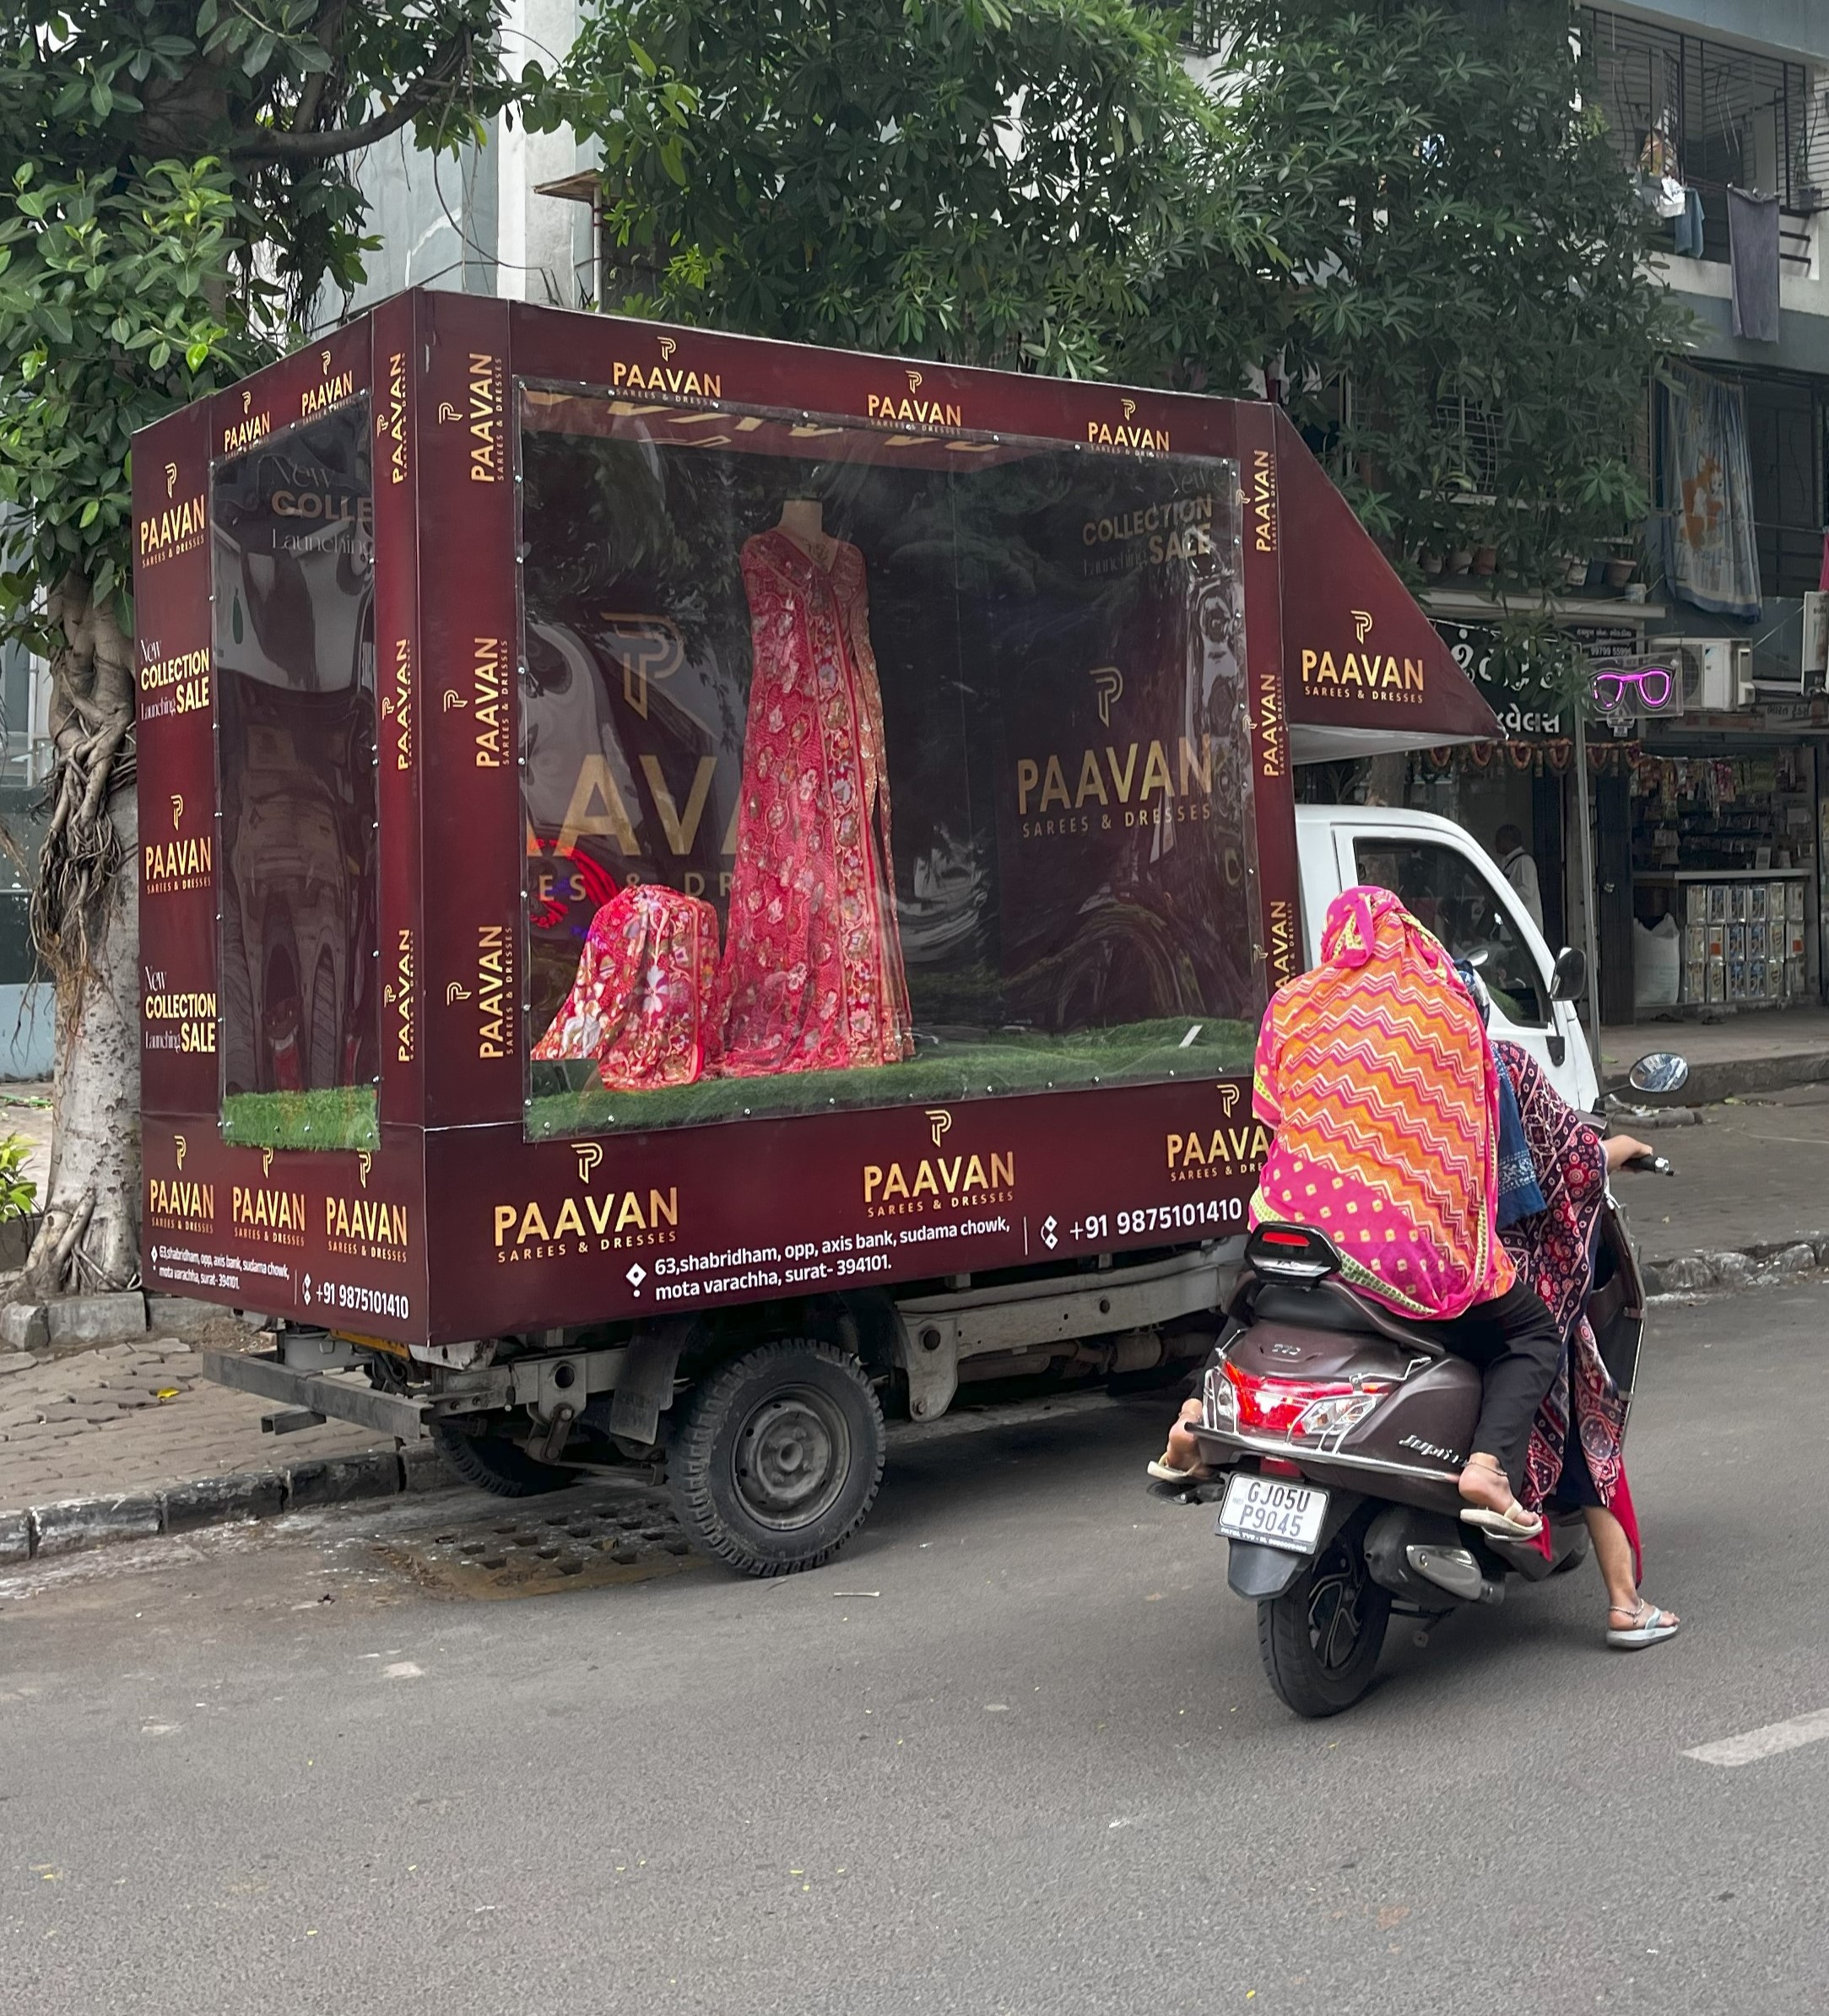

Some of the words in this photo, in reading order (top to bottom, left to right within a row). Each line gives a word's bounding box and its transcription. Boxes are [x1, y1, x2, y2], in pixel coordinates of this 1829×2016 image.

[301, 370, 353, 416] PAAVAN
[495, 358, 503, 412] DRESSES
[613, 362, 721, 398] PAAVAN
[225, 411, 270, 452] PAAVAN
[390, 353, 404, 484] PAAVAN
[469, 353, 495, 483] PAAVAN
[868, 394, 961, 427] PAAVAN
[1088, 422, 1169, 451] PAAVAN
[1083, 493, 1212, 546] COLLECTION
[1254, 450, 1271, 552] PAAVAN
[141, 494, 205, 555] PAAVAN
[1149, 522, 1211, 565] SALE
[141, 647, 209, 690] COLLECTION
[1301, 649, 1424, 691] PAAVAN
[176, 676, 209, 714] SALE
[396, 639, 409, 770] PAAVAN
[474, 638, 500, 767] PAAVAN
[1305, 685, 1350, 698] SAREES
[1357, 689, 1365, 700] &
[1372, 691, 1423, 704] DRESSES
[501, 718, 510, 765] SAREES
[1260, 674, 1279, 776] PAAVAN
[1017, 732, 1212, 815] PAAVAN
[1022, 816, 1089, 838] SAREES
[1101, 814, 1112, 830] &
[1124, 803, 1210, 827] DRESSES
[145, 836, 211, 880] PAAVAN
[147, 882, 171, 894] SAREES
[182, 876, 211, 889] DRESSES
[505, 927, 513, 983] DRESSES
[1270, 900, 1291, 989] AAVAN
[145, 993, 217, 1019] COLLECTION
[398, 929, 410, 1062] PAAVAN
[479, 926, 504, 1058] PAAVAN
[181, 1022, 216, 1052] SALE
[1166, 1125, 1269, 1168] PAAVA
[863, 1151, 1015, 1203] PAAVAN
[1171, 1167, 1218, 1181] SAREES
[1225, 1165, 1233, 1176] &
[150, 1179, 214, 1219] PAAVAN
[232, 1186, 305, 1231] PAAVAN
[495, 1186, 678, 1247] PAAVAN
[868, 1201, 923, 1218] SAREES
[933, 1199, 941, 1209] &
[951, 1191, 1014, 1208] DRESSES
[1070, 1214, 1107, 1240] +91
[1117, 1197, 1242, 1235] 9875101410
[326, 1197, 407, 1246] PAAVAN
[327, 1240, 357, 1255] SAREES
[361, 1245, 366, 1257] &
[371, 1246, 407, 1262] DRESSES
[498, 1244, 566, 1263] SAREES
[578, 1241, 588, 1253] &
[601, 1230, 676, 1251] DRESSES
[655, 1243, 782, 1276] 63,shabridham,
[785, 1242, 819, 1262] opp,
[822, 1235, 852, 1254] axis
[856, 1230, 896, 1249] bank,
[900, 1225, 957, 1244] sudama
[960, 1216, 1010, 1235] chowk,
[655, 1279, 700, 1300] mota
[703, 1267, 782, 1294] varachha,
[785, 1265, 834, 1285] surat-
[836, 1254, 891, 1276] 394101.
[316, 1281, 335, 1305] +91
[339, 1284, 409, 1320] 9875101410
[1247, 1482, 1311, 1512] GJ05U
[1240, 1505, 1303, 1537] P9045
